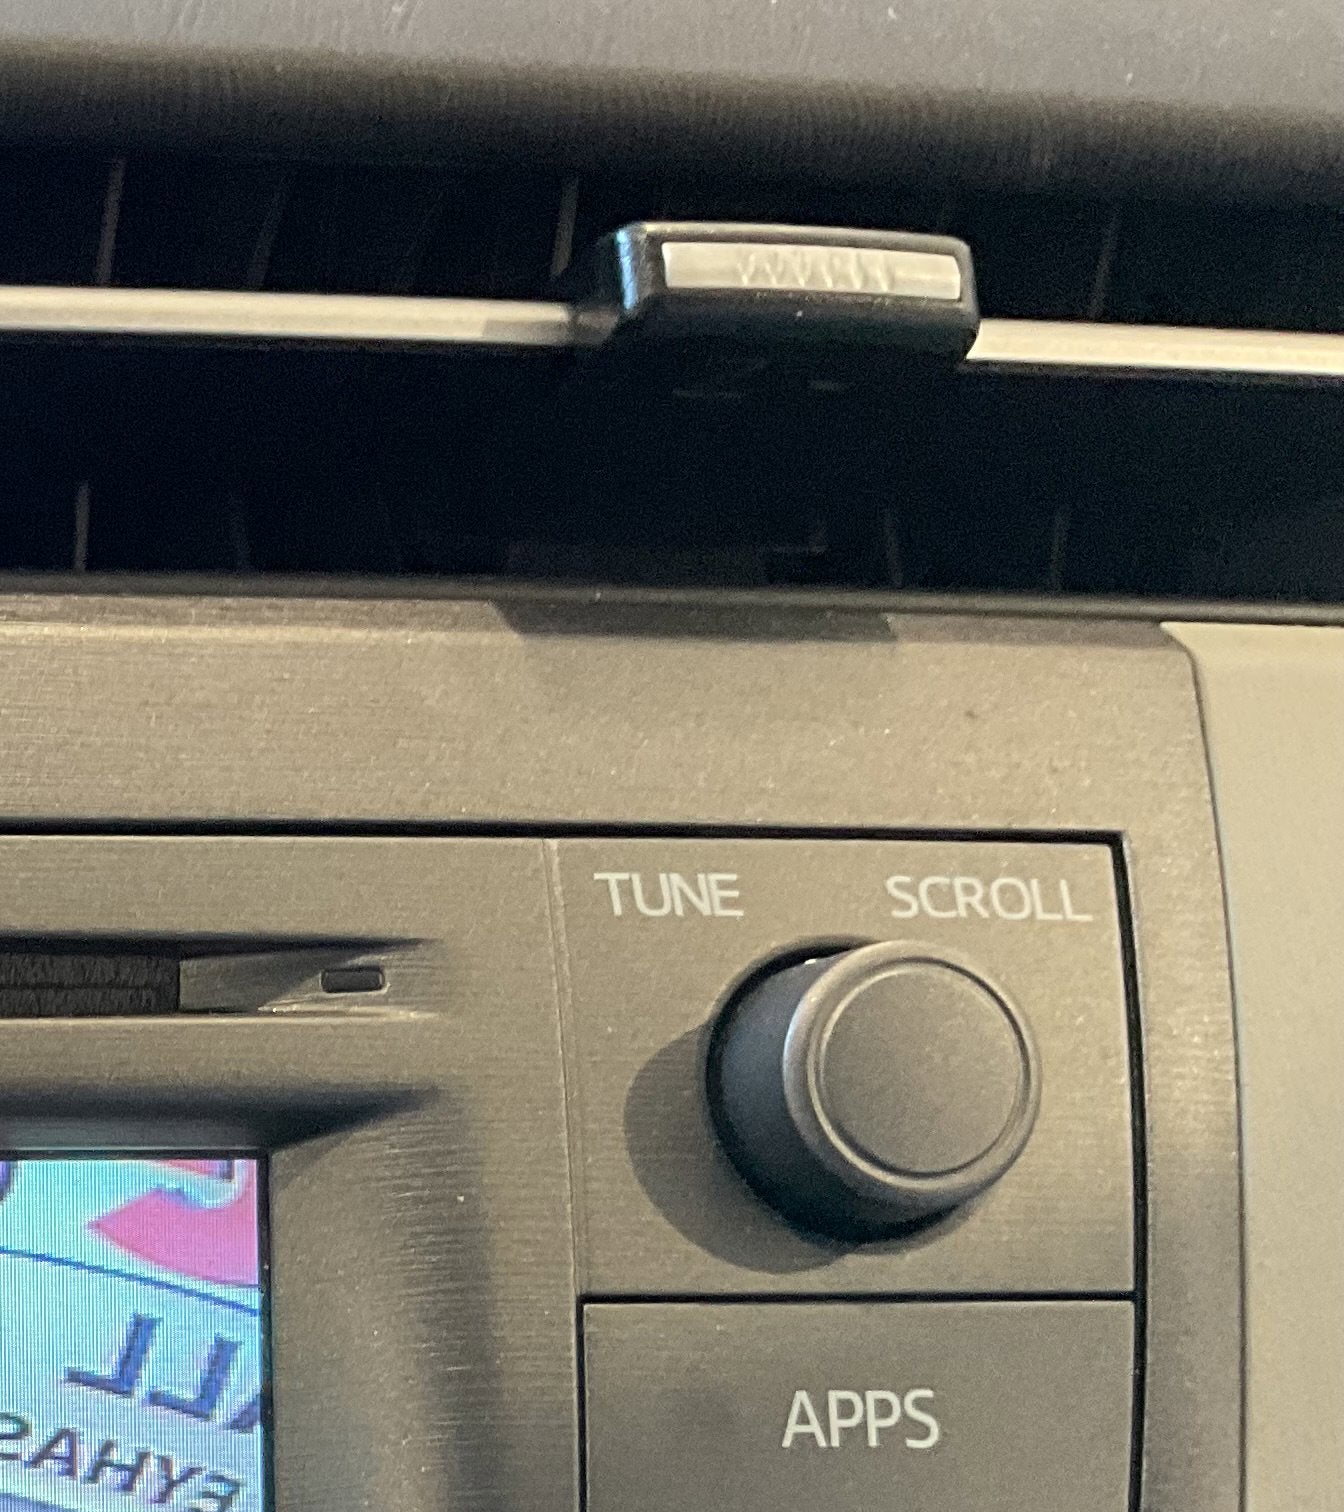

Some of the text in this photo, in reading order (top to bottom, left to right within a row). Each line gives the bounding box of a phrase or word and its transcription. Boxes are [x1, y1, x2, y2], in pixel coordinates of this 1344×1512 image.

[593, 872, 744, 917] TUNE
[885, 875, 1093, 922] SCROLL
[781, 1389, 941, 1448] APPS
